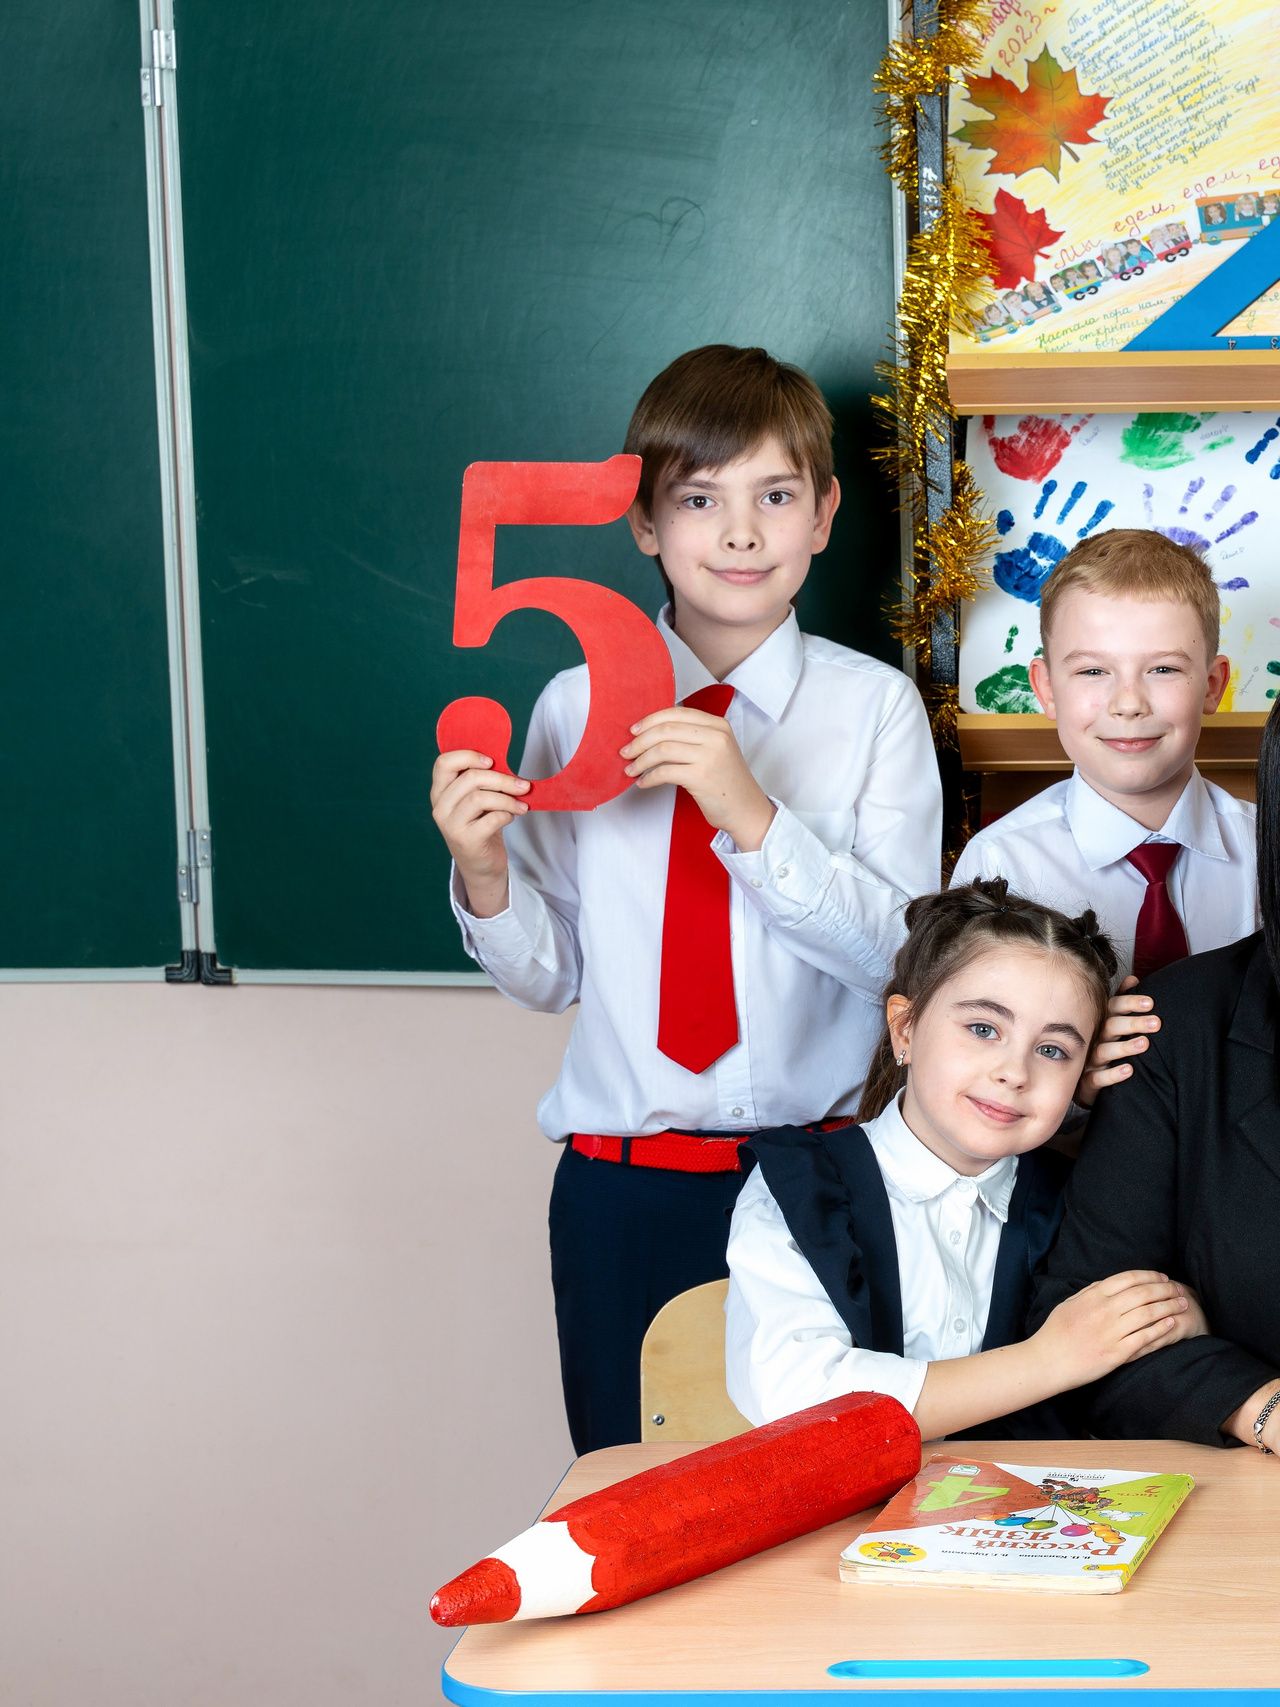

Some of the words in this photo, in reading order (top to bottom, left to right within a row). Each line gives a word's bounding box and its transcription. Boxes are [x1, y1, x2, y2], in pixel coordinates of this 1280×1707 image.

[998, 9, 1042, 68] 2023
[1098, 14, 1115, 35] день
[1128, 30, 1168, 61] главный
[1054, 239, 1102, 271] Мы
[1113, 203, 1176, 238] едем,
[1183, 171, 1251, 199] едем,
[1035, 317, 1100, 348] Настала
[1103, 307, 1133, 323] пора
[1138, 298, 1167, 312] нам
[1228, 338, 1237, 350] 4
[1271, 337, 1280, 350] 3
[436, 454, 676, 812] 5
[915, 1475, 1010, 1512] 4
[1143, 1485, 1164, 1494] 2
[973, 1540, 1124, 1556] Русский
